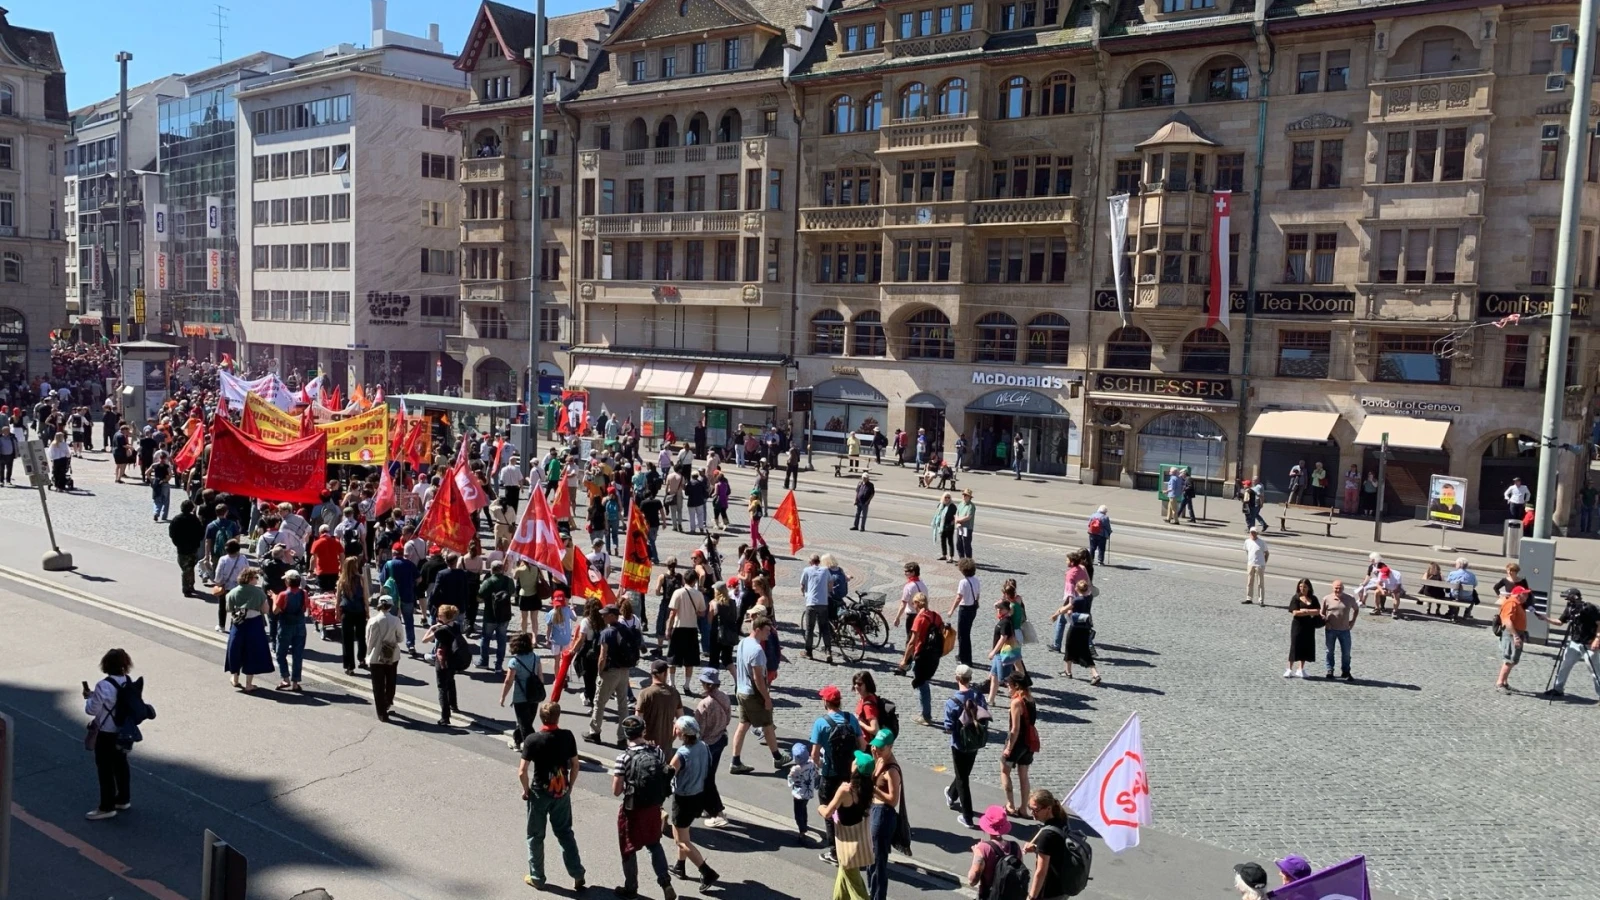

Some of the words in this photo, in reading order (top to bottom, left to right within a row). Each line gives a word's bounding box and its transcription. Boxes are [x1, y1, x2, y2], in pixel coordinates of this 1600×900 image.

[367, 290, 411, 307] flying
[1260, 292, 1355, 312] Tea-Room
[370, 304, 408, 319] tiger
[972, 371, 1063, 389] McDonald's
[1102, 376, 1225, 397] SCHIESSER
[1361, 398, 1404, 409] Davidoff
[1405, 400, 1415, 409] of
[1418, 401, 1461, 412] Geneva
